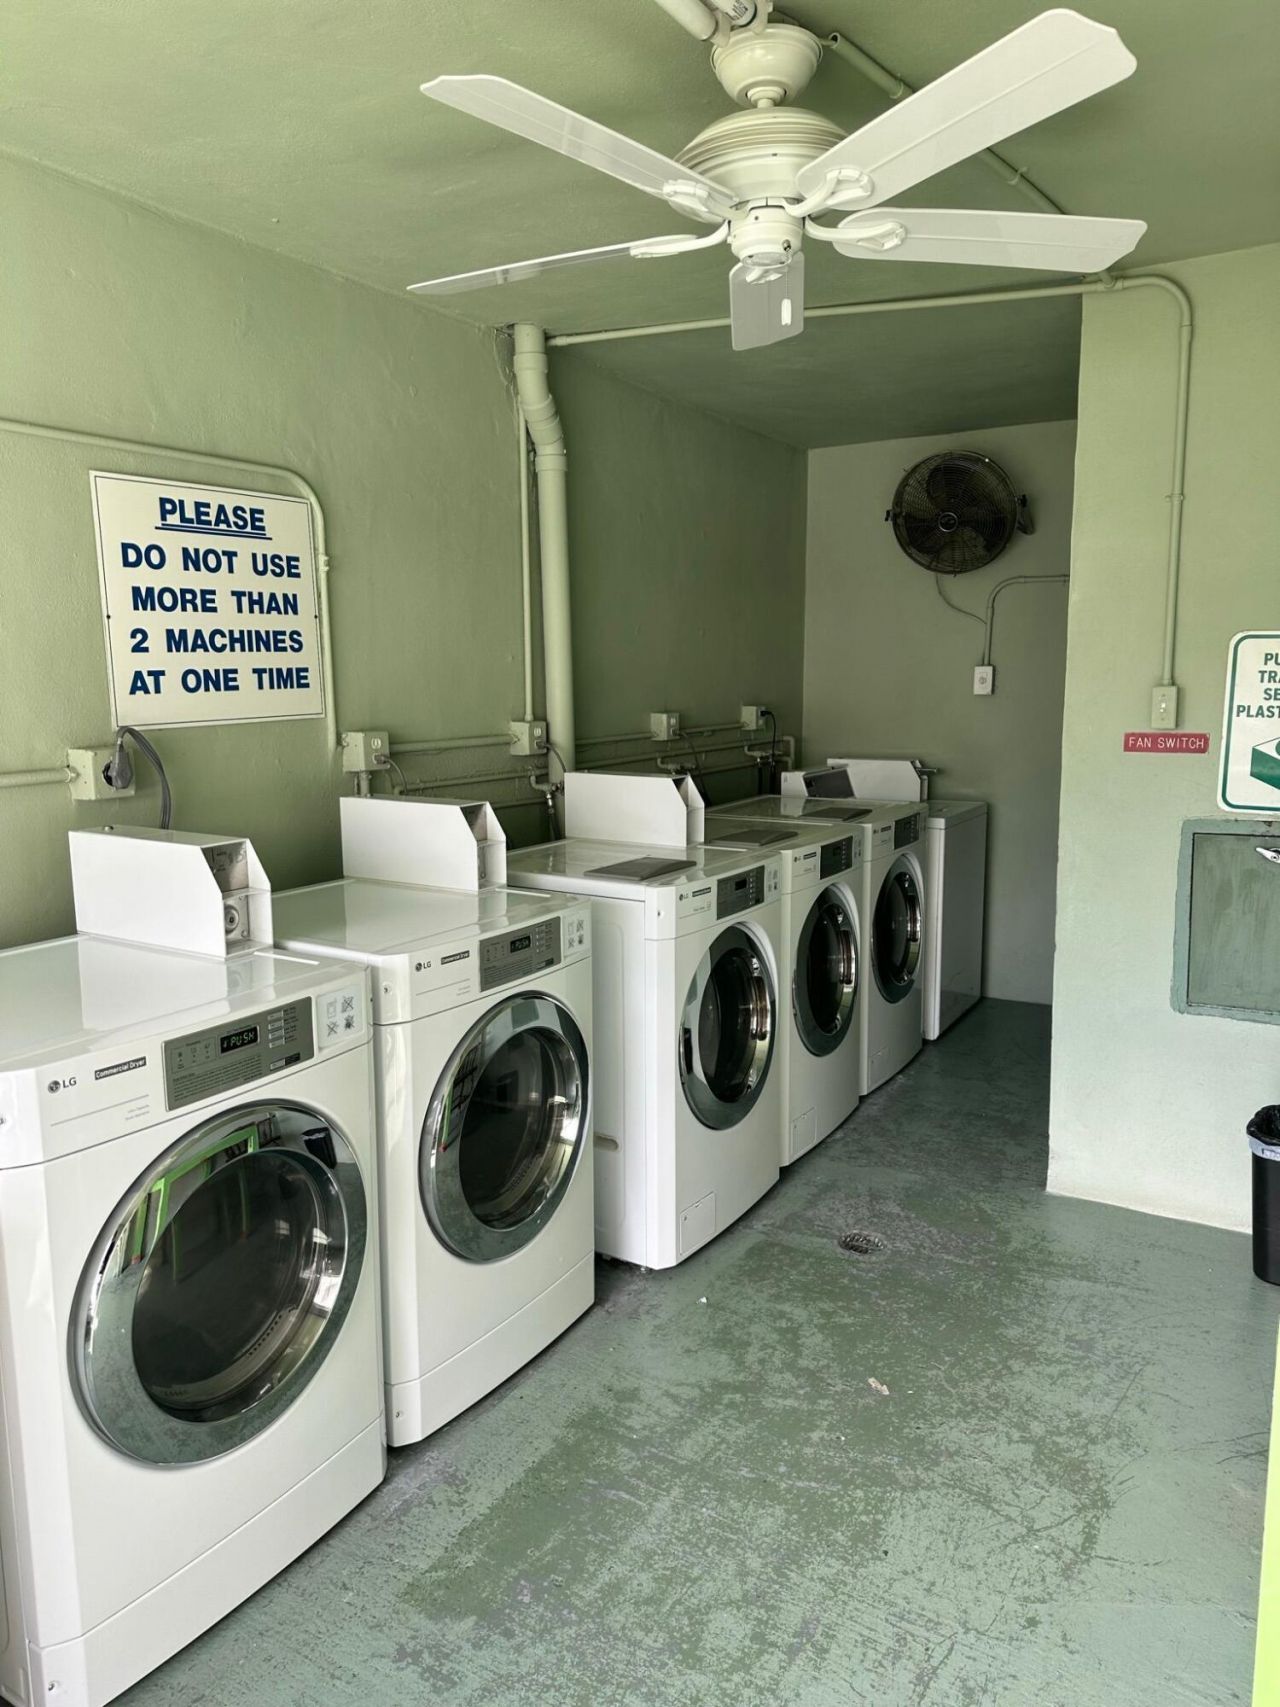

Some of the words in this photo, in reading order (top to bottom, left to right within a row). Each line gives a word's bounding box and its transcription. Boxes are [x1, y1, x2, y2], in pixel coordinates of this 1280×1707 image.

[158, 496, 266, 532] PLEASE
[121, 542, 167, 570] DO
[181, 546, 238, 574] NOT
[251, 552, 301, 579] USE
[131, 586, 218, 613] MORE
[231, 590, 299, 616] THAN
[130, 628, 150, 653] 2
[165, 628, 304, 653] MACHINES
[129, 669, 166, 695] AT
[181, 668, 240, 693] ONE
[252, 667, 310, 691] TIME
[1258, 670, 1280, 684] TR
[1263, 687, 1280, 701] SE
[1128, 736, 1152, 748] FAN
[1157, 737, 1205, 750] SWITCH
[96, 1063, 129, 1079] Commercial
[129, 1058, 145, 1069] Dryer
[62, 1077, 77, 1089] LG
